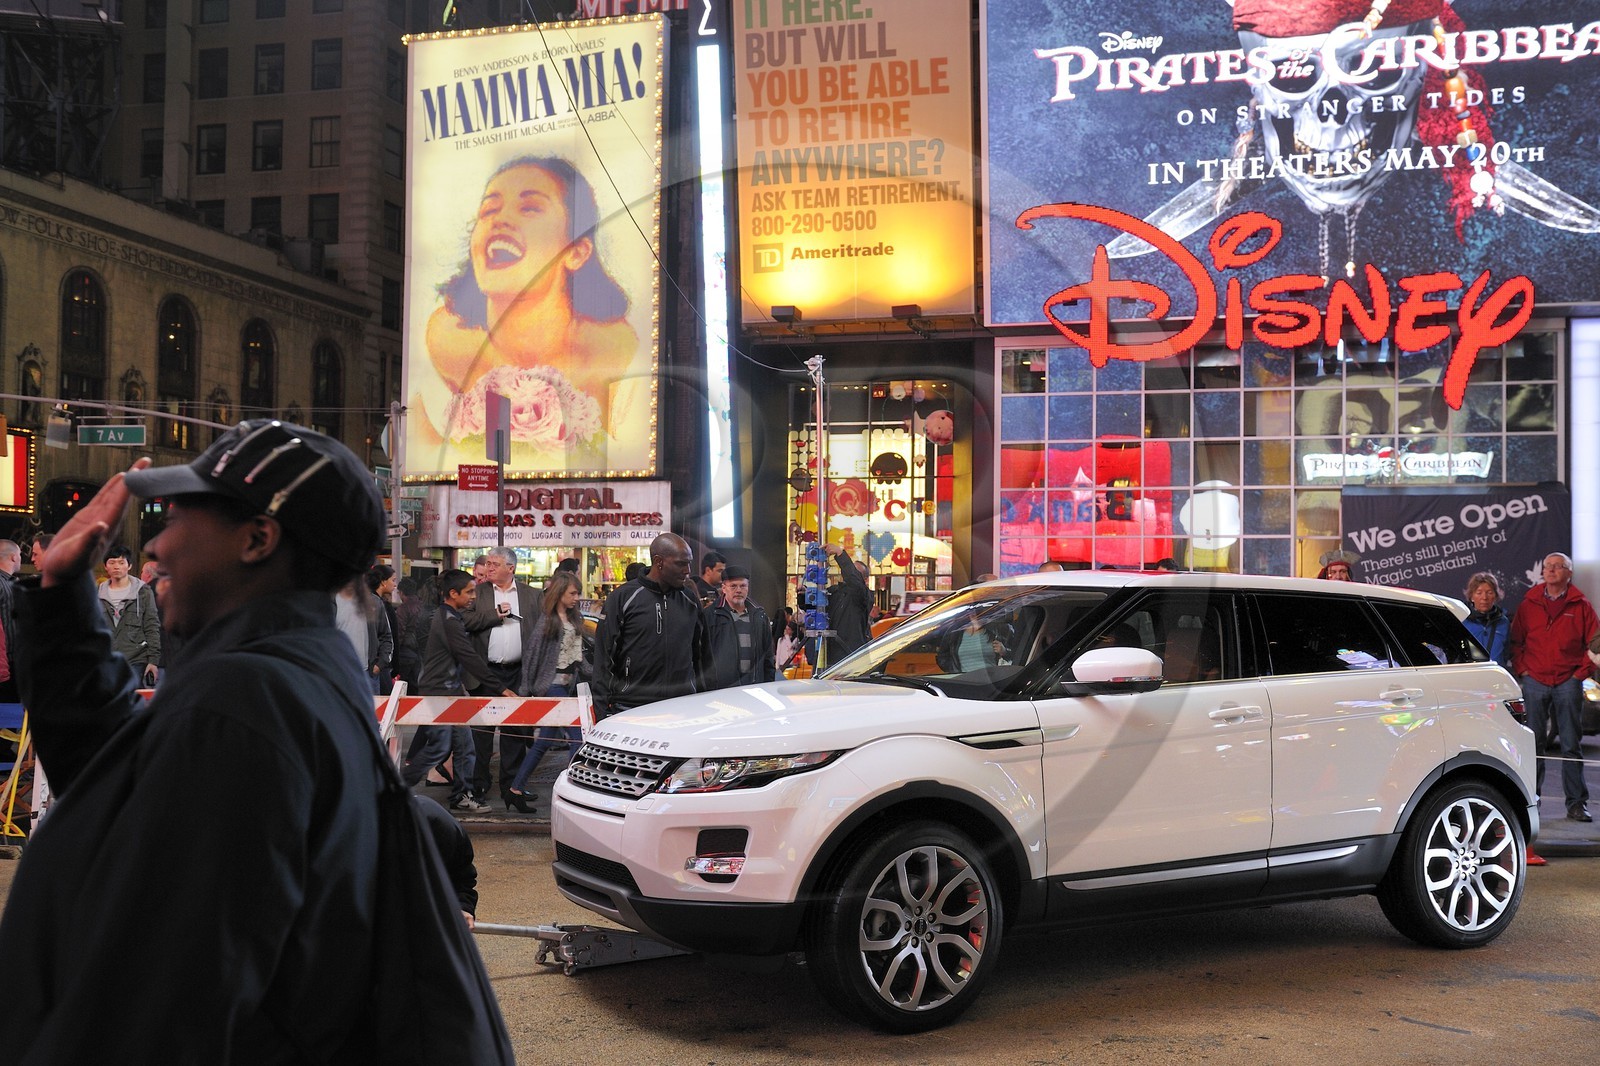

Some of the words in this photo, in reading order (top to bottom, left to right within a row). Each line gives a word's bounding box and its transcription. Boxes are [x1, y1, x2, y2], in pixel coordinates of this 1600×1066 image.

[745, 0, 768, 29] IT
[782, 0, 873, 26] HERE.
[745, 28, 807, 69] BUT
[813, 21, 897, 63] WILL
[453, 65, 480, 78] BENNY
[482, 53, 530, 71] ANDERSSON
[532, 52, 540, 61] &
[746, 68, 809, 108] YOU
[818, 64, 858, 103] BE
[866, 57, 950, 99] ABLE
[1035, 38, 1276, 102] PIRATES
[1277, 60, 1315, 79] the
[420, 63, 557, 143] MAMMA
[562, 41, 646, 112] MIA!
[1176, 108, 1218, 126] ON
[1236, 95, 1407, 122] STRANGER
[1427, 86, 1526, 109] TIDES
[455, 139, 471, 151] THE
[473, 130, 502, 147] SMASH
[504, 127, 518, 141] HIT
[520, 121, 557, 138] MUSICAL
[586, 110, 616, 124] ABBA
[749, 109, 789, 147] TO
[800, 100, 912, 144] RETIRE
[751, 138, 945, 187] ANYWHERE?
[1147, 161, 1185, 185] IN
[1196, 148, 1372, 183] THEATERS
[1384, 145, 1461, 171] MAY
[1470, 141, 1546, 167] 20TH
[751, 190, 787, 212] ASK
[791, 187, 840, 210] TEAM
[846, 181, 965, 207] RETIREMENT.
[27, 213, 73, 243] FOLKS
[79, 231, 117, 256] SHOE
[121, 245, 156, 268] SHOP
[751, 209, 877, 237] 800-290-0500
[754, 247, 782, 269] TD
[791, 242, 894, 260] Ameritrade
[97, 430, 104, 441] 7
[107, 430, 124, 441] Av
[471, 467, 496, 475] STOPPING
[503, 487, 622, 511] DIGITAL
[455, 513, 536, 528] CAMERAS
[542, 513, 557, 528] &
[562, 511, 664, 527] COMPUTERS
[480, 532, 497, 540] HOUR
[531, 531, 562, 540] LUGGAGE
[571, 531, 581, 539] NY
[584, 531, 621, 539] SOUVENIRS
[1347, 526, 1397, 553] We
[1401, 515, 1455, 542] are
[1460, 494, 1549, 530] Open
[1360, 551, 1413, 573] There's
[1415, 546, 1440, 561] still
[1443, 534, 1489, 556] plenty
[1491, 529, 1508, 544] of
[1365, 568, 1413, 586] Magic
[1415, 552, 1478, 577] upstairs!
[621, 736, 670, 751] ROVER
